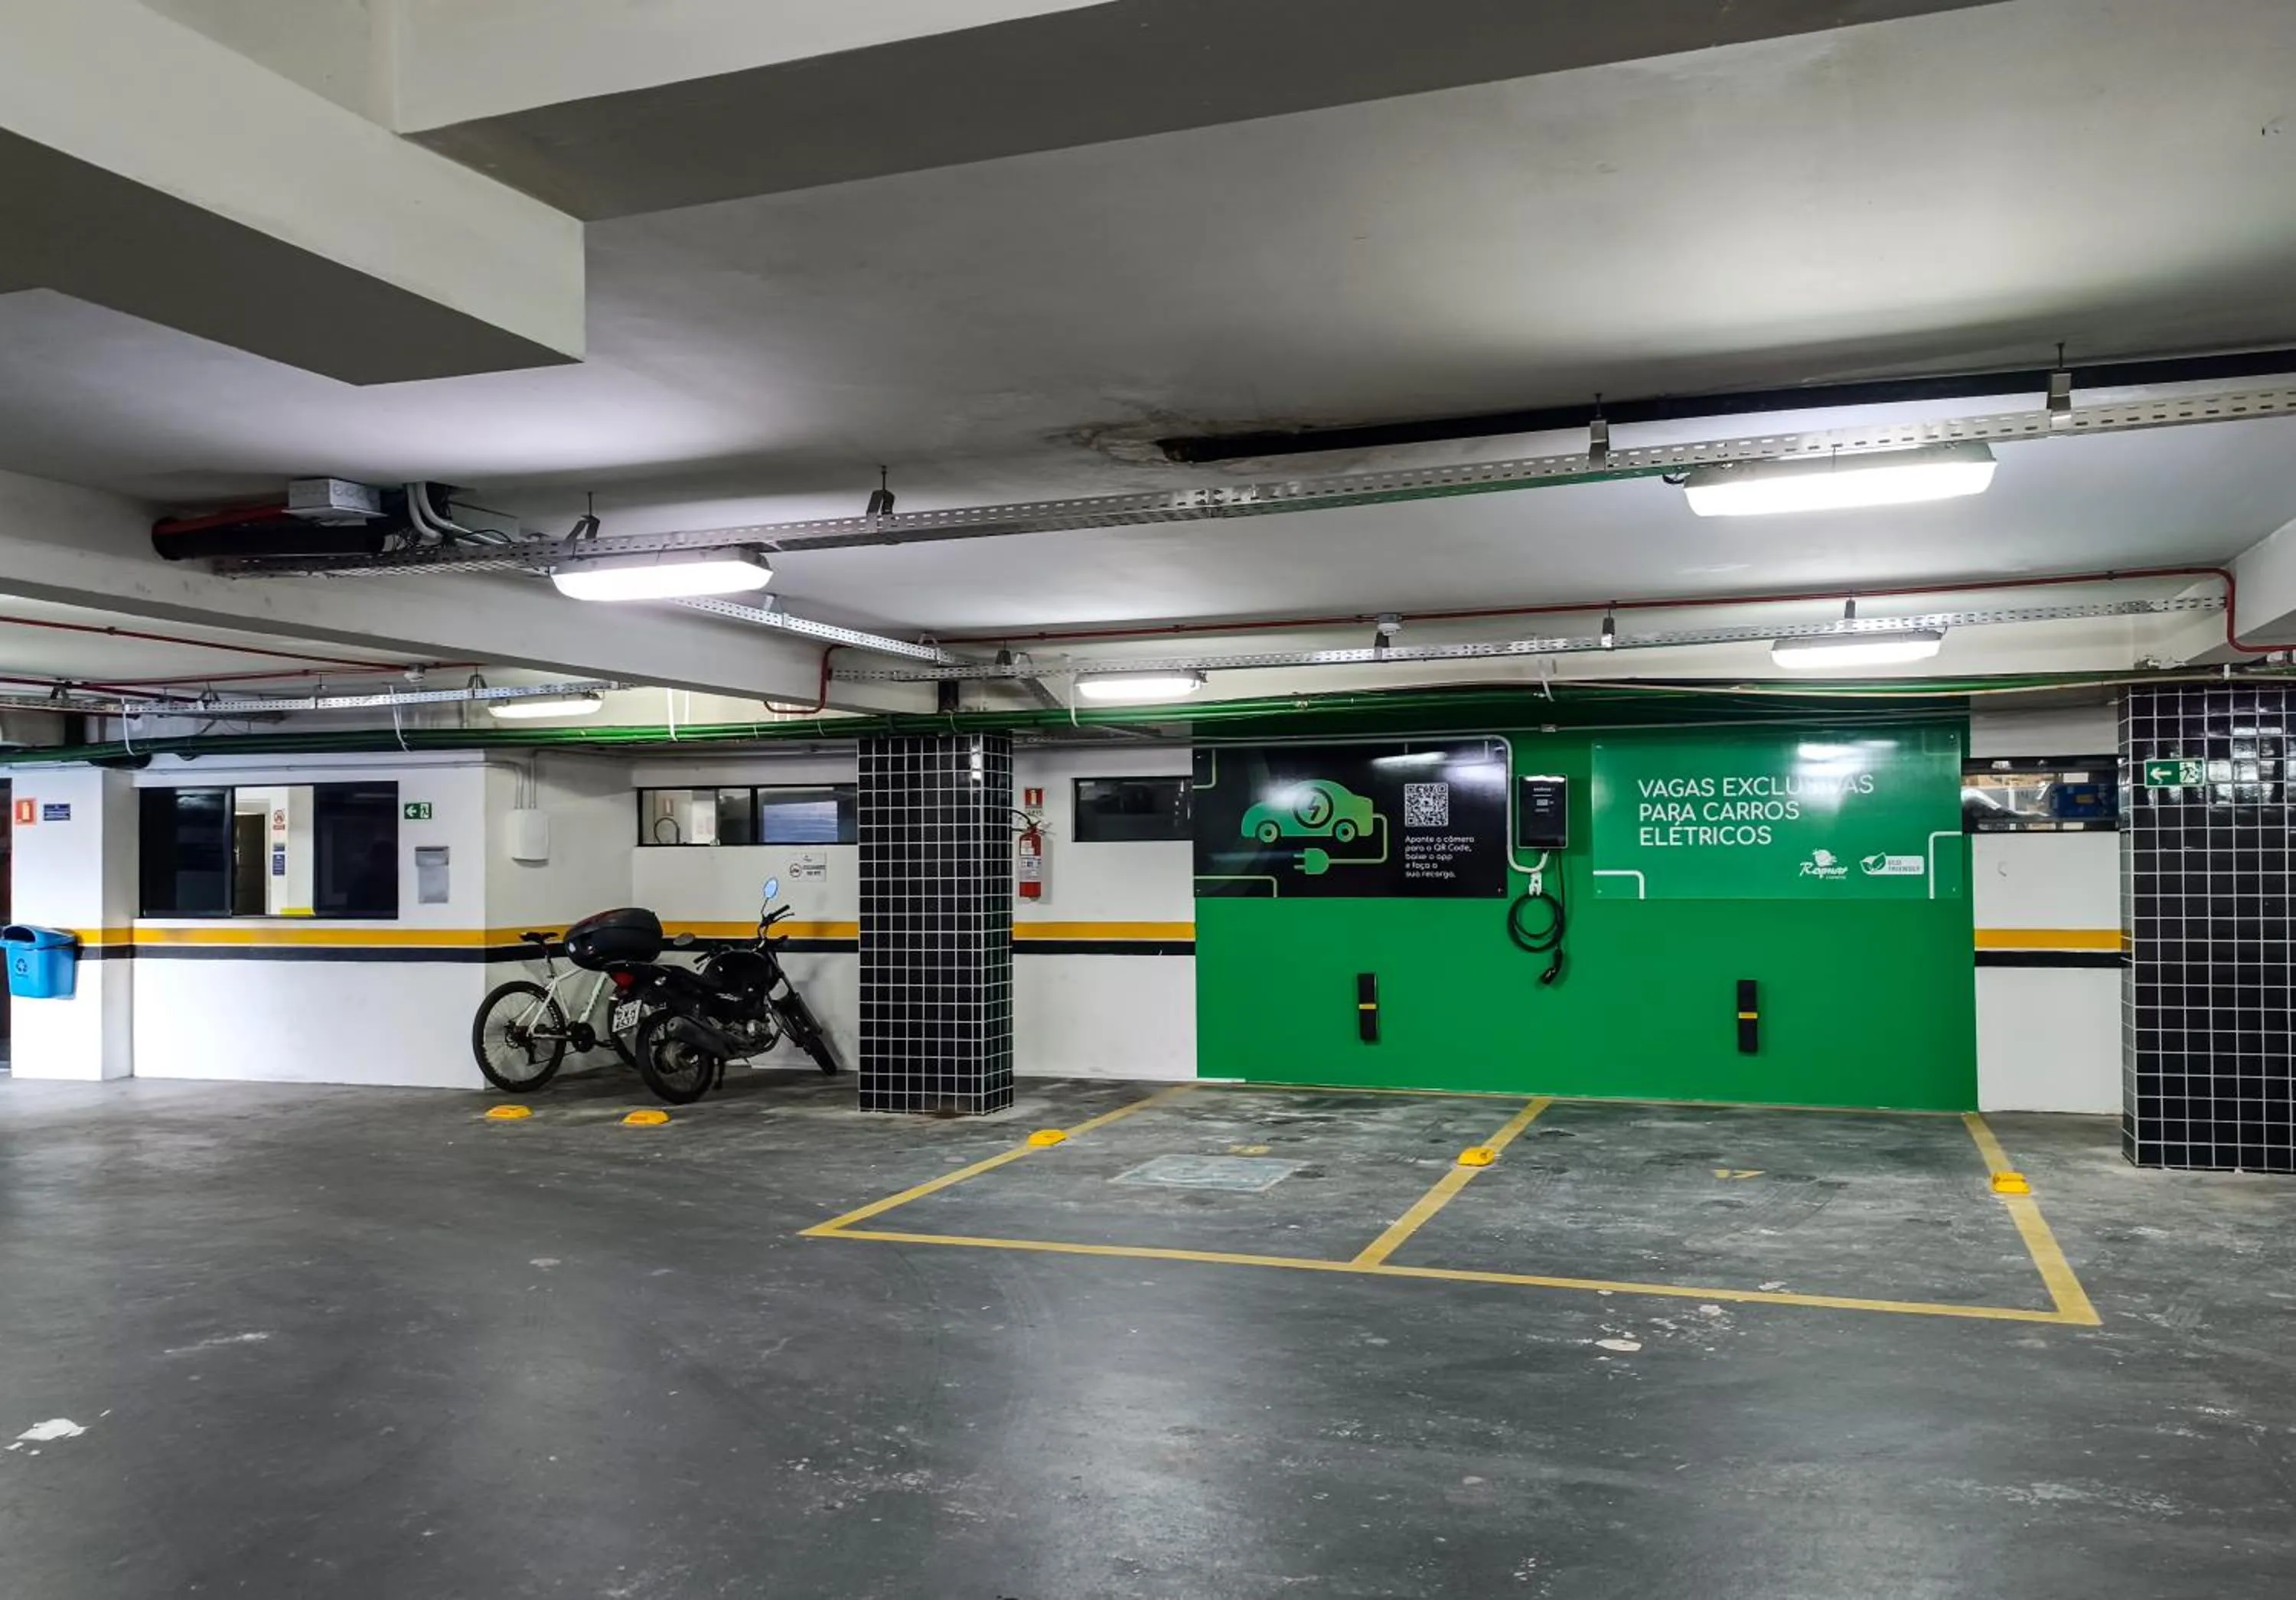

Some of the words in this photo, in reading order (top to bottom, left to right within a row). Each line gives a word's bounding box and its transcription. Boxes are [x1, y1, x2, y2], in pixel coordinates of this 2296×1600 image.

[1638, 779, 1715, 798] VAGAS
[1723, 775, 1874, 797] EXCLUAS
[1639, 803, 1697, 822] PARA
[1703, 802, 1799, 821] CARROS
[1640, 816, 1773, 846] ELÉTRICOS
[1404, 835, 1434, 844] Aponte
[1433, 843, 1446, 851] QR
[1412, 861, 1430, 870] faça
